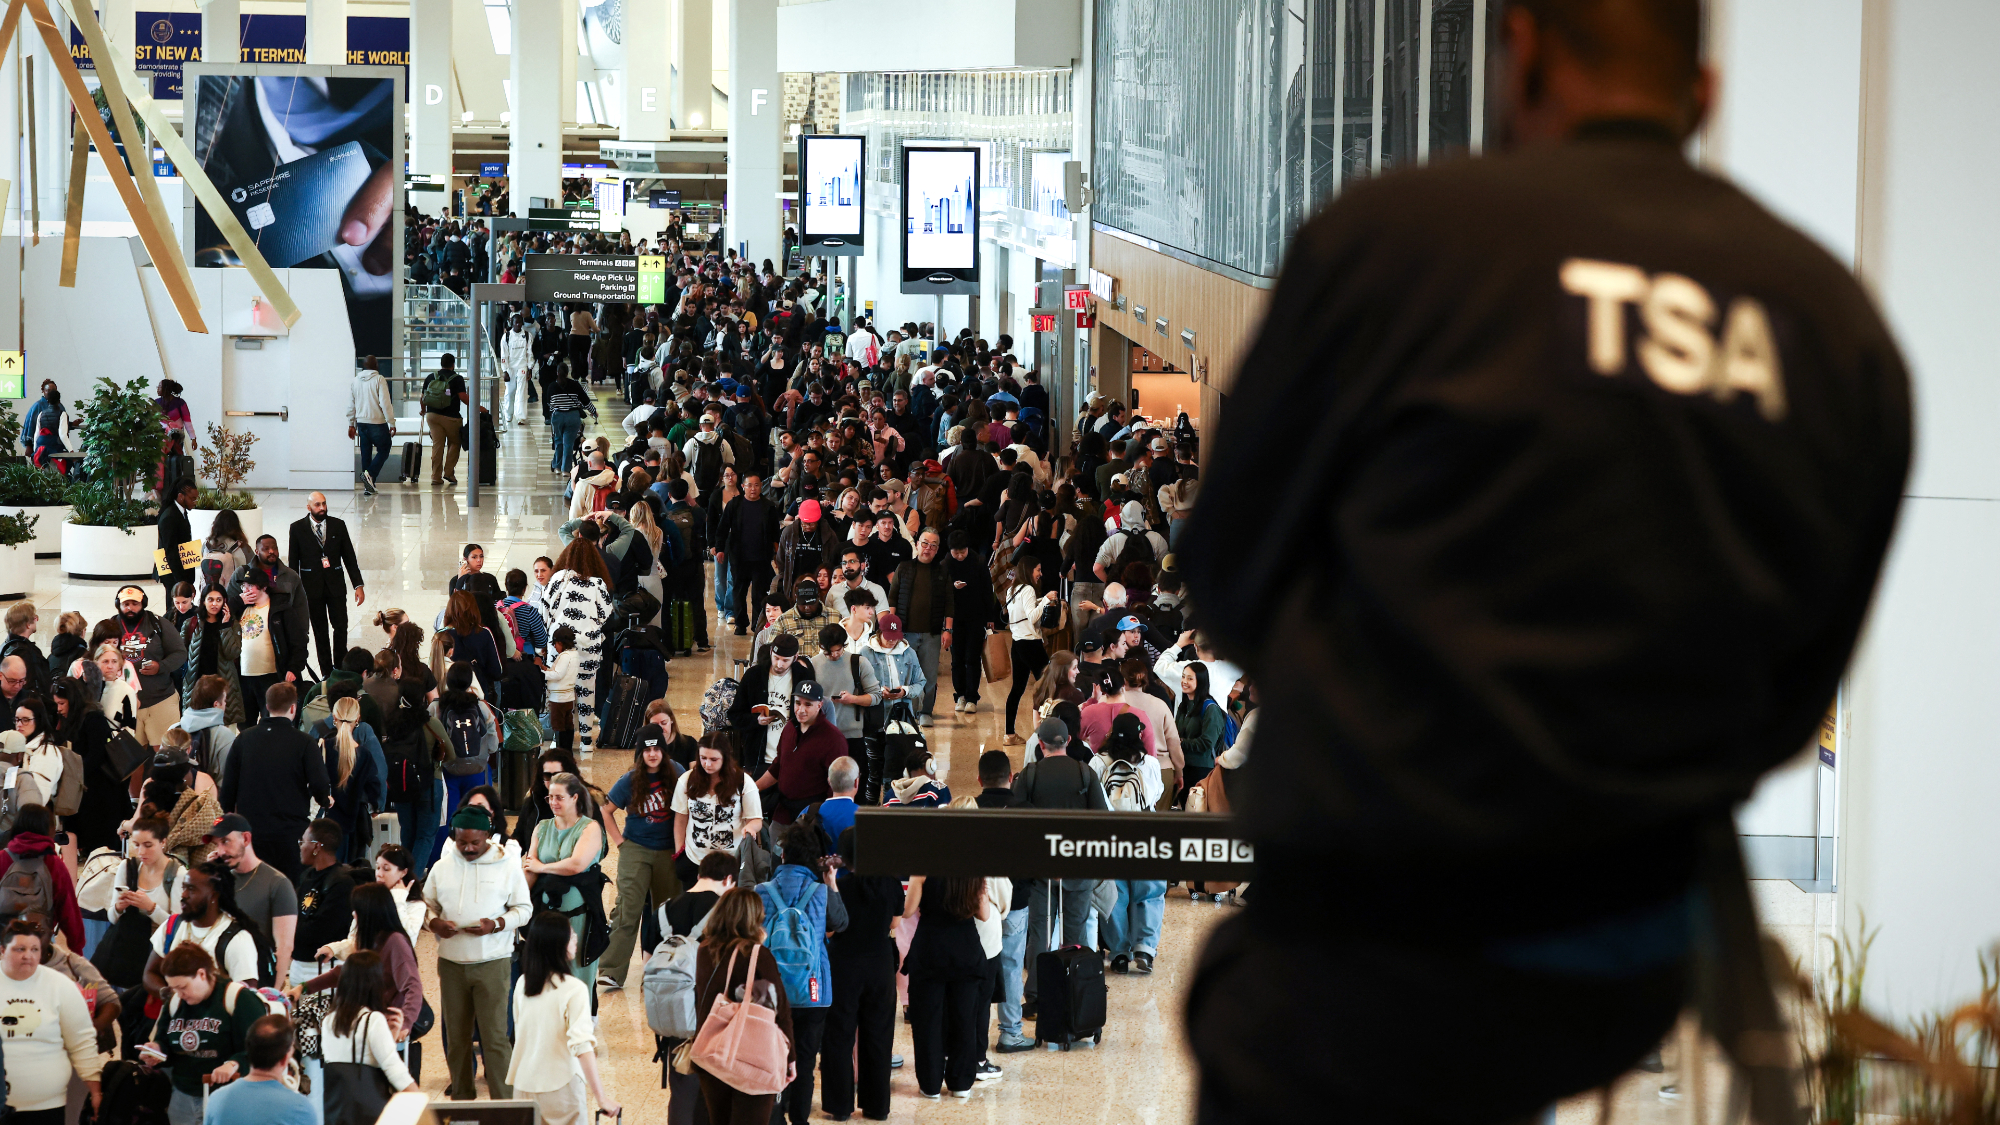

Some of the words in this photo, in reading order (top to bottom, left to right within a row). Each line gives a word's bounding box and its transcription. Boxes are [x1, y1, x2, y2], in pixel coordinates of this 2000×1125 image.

[156, 46, 187, 60] NEW
[138, 63, 178, 71] demonstrate
[425, 84, 443, 106] D
[641, 87, 656, 112] E
[750, 88, 768, 116] F
[574, 273, 590, 281] Ride
[592, 274, 606, 282] App
[582, 292, 635, 301] Transportation
[600, 284, 627, 292] Parking
[1558, 258, 1788, 424] TSA
[1045, 834, 1173, 859] Terminals
